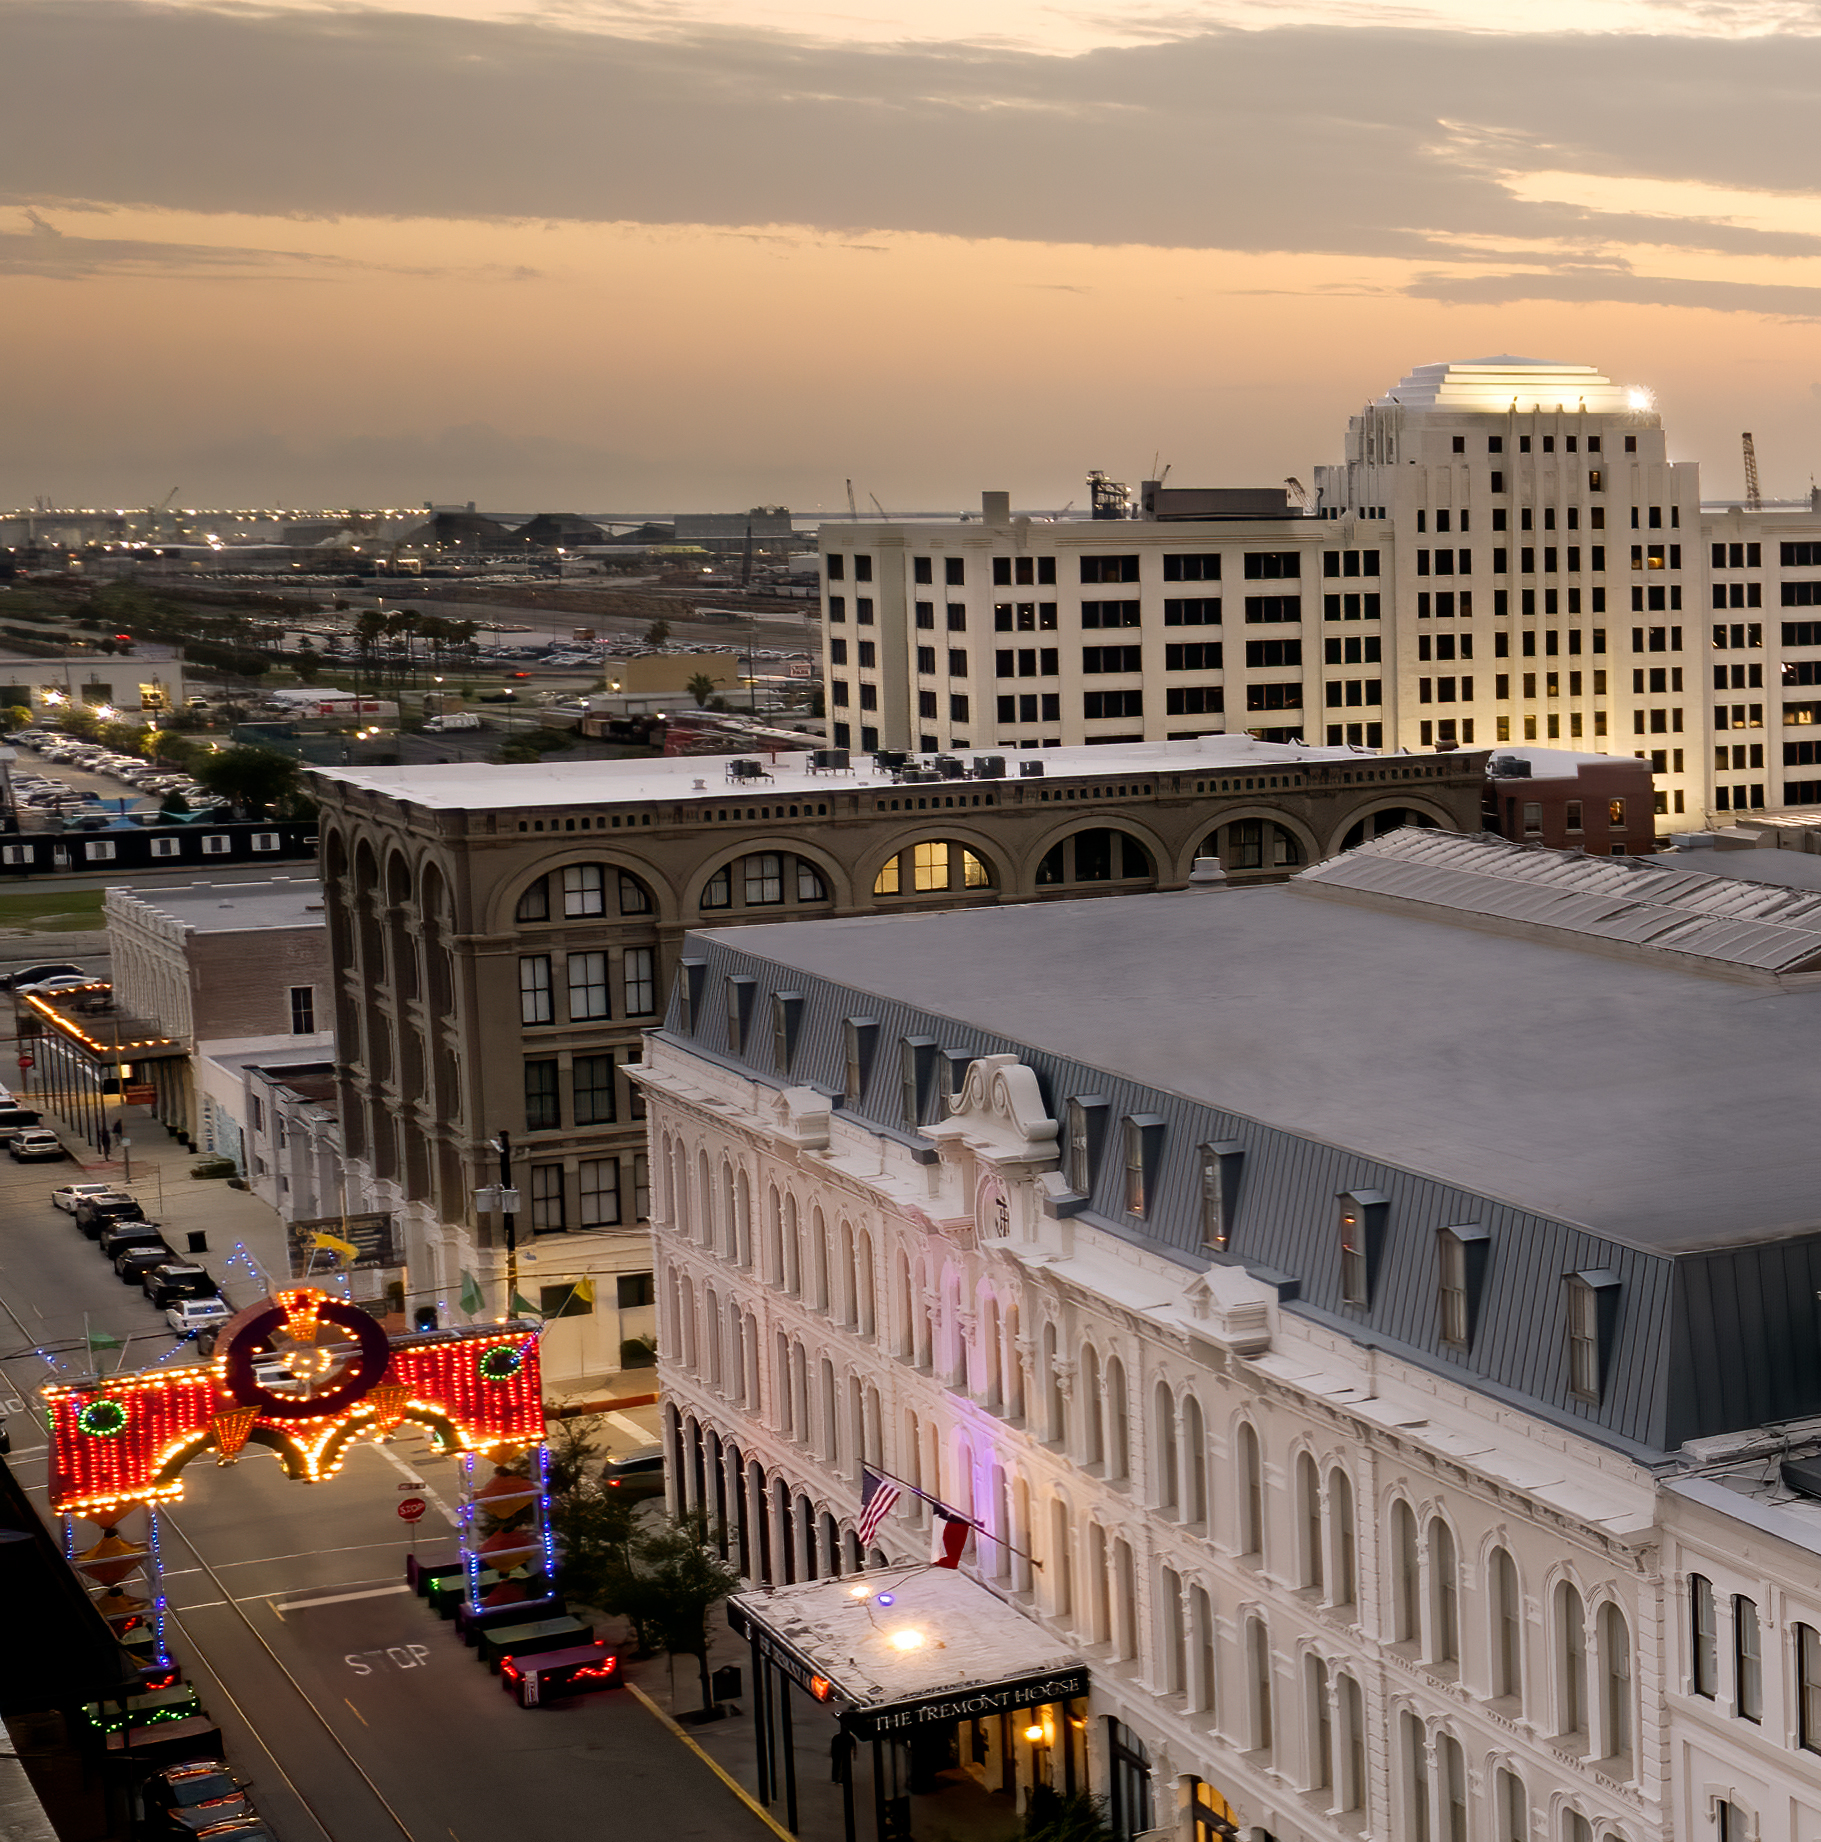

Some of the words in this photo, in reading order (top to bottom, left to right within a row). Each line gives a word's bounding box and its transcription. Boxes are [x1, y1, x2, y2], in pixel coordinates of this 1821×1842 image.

[400, 1502, 425, 1515] STOP
[344, 1644, 430, 1676] STOP
[875, 1711, 912, 1731] THE
[917, 1691, 1011, 1723] TREMONT
[1014, 1678, 1080, 1702] HOUSE
